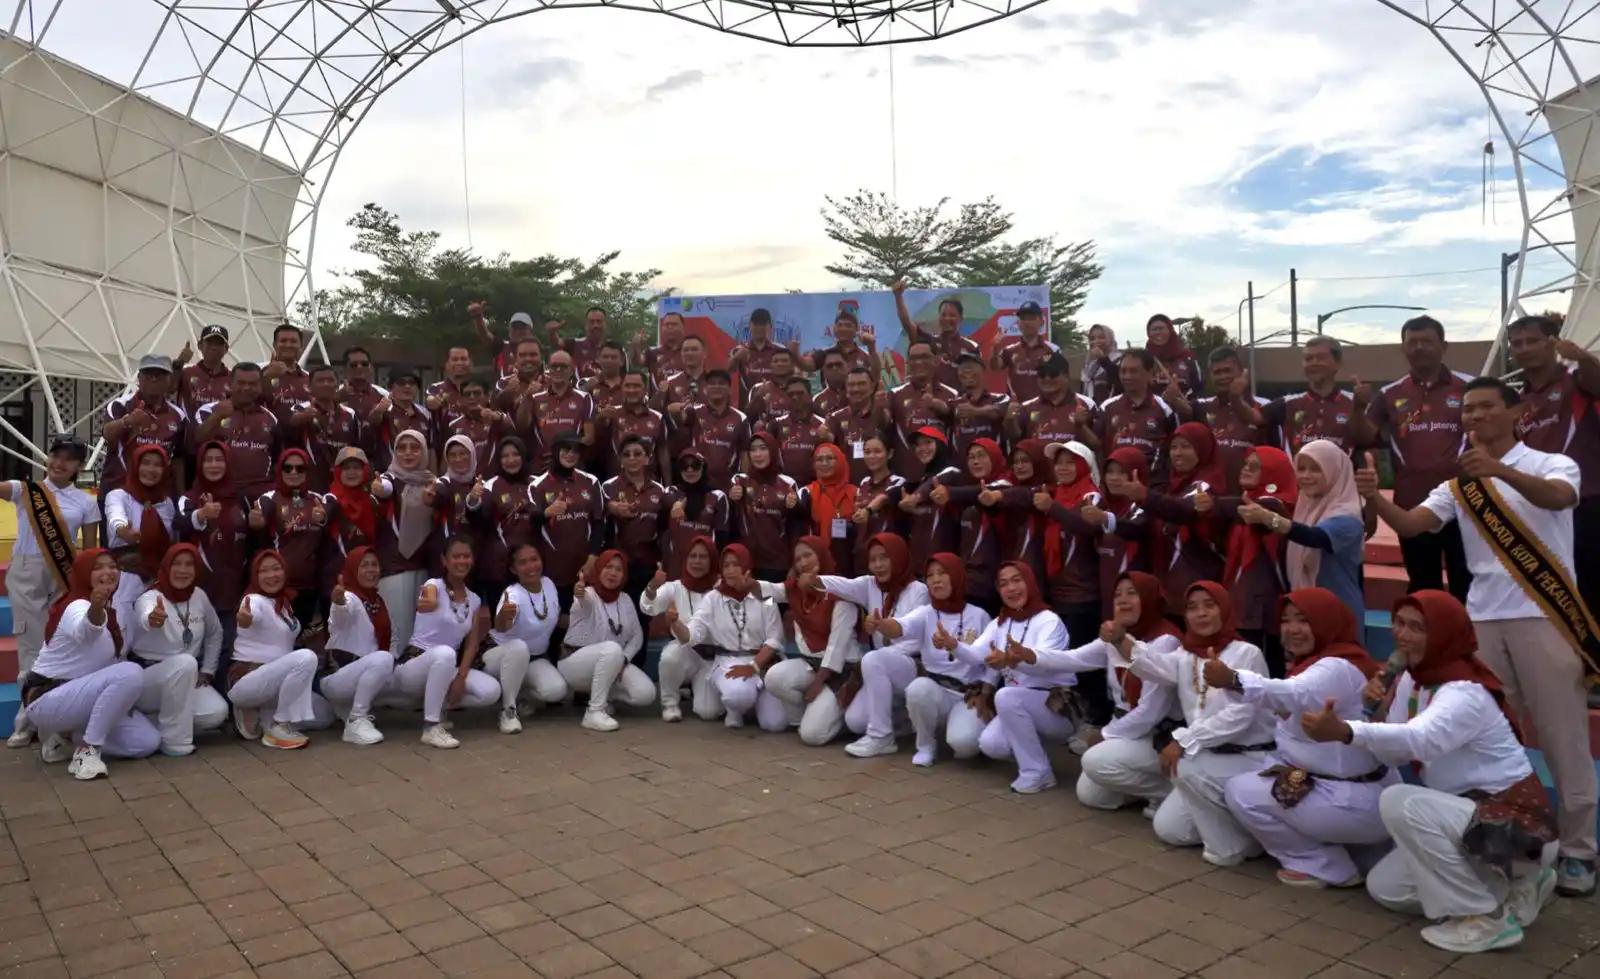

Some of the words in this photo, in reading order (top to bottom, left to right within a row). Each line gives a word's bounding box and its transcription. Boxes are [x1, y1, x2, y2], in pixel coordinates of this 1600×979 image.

[1408, 422, 1428, 432] Bank
[1430, 421, 1457, 432] Jateng
[1483, 506, 1515, 547] WISATA
[1510, 542, 1540, 573] KOTA
